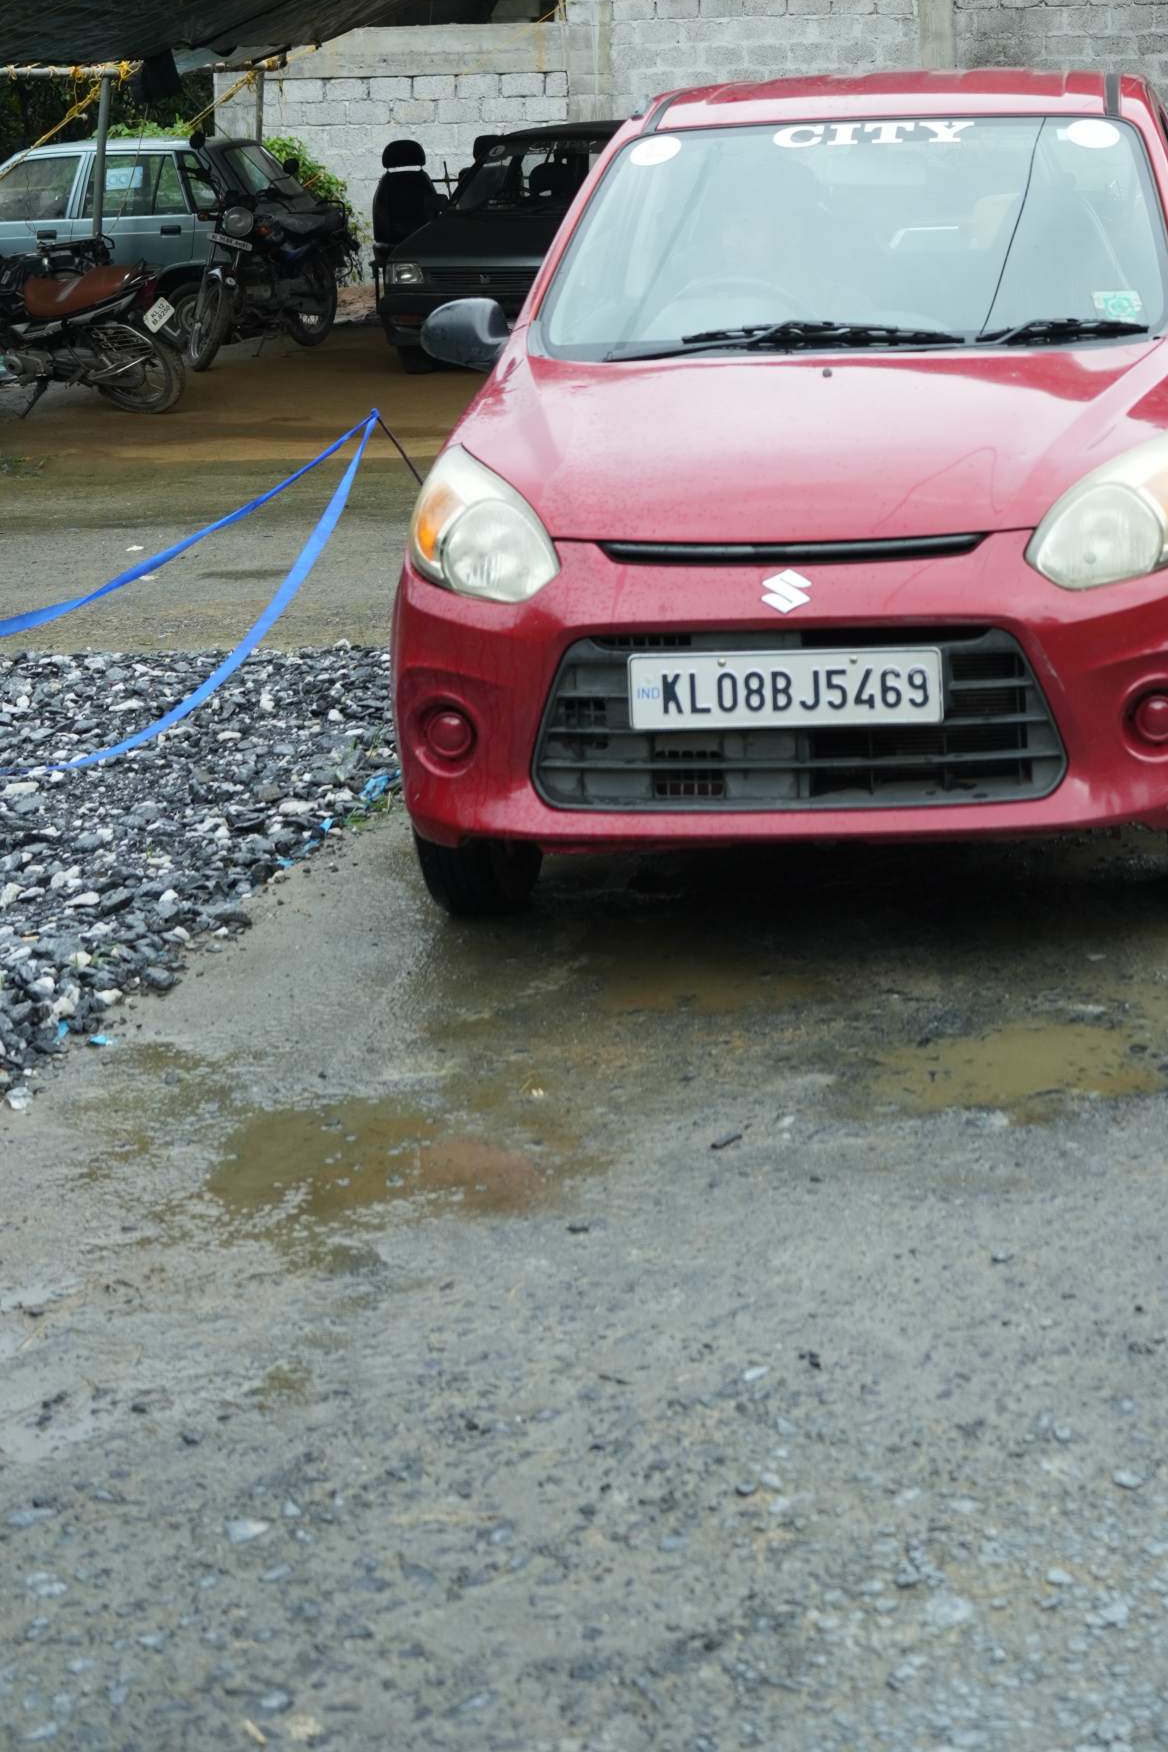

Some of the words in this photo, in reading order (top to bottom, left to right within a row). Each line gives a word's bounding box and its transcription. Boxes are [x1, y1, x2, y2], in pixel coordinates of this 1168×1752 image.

[773, 121, 975, 148] CITY
[637, 688, 660, 700] IND
[662, 668, 929, 715] KL08BJ5469
